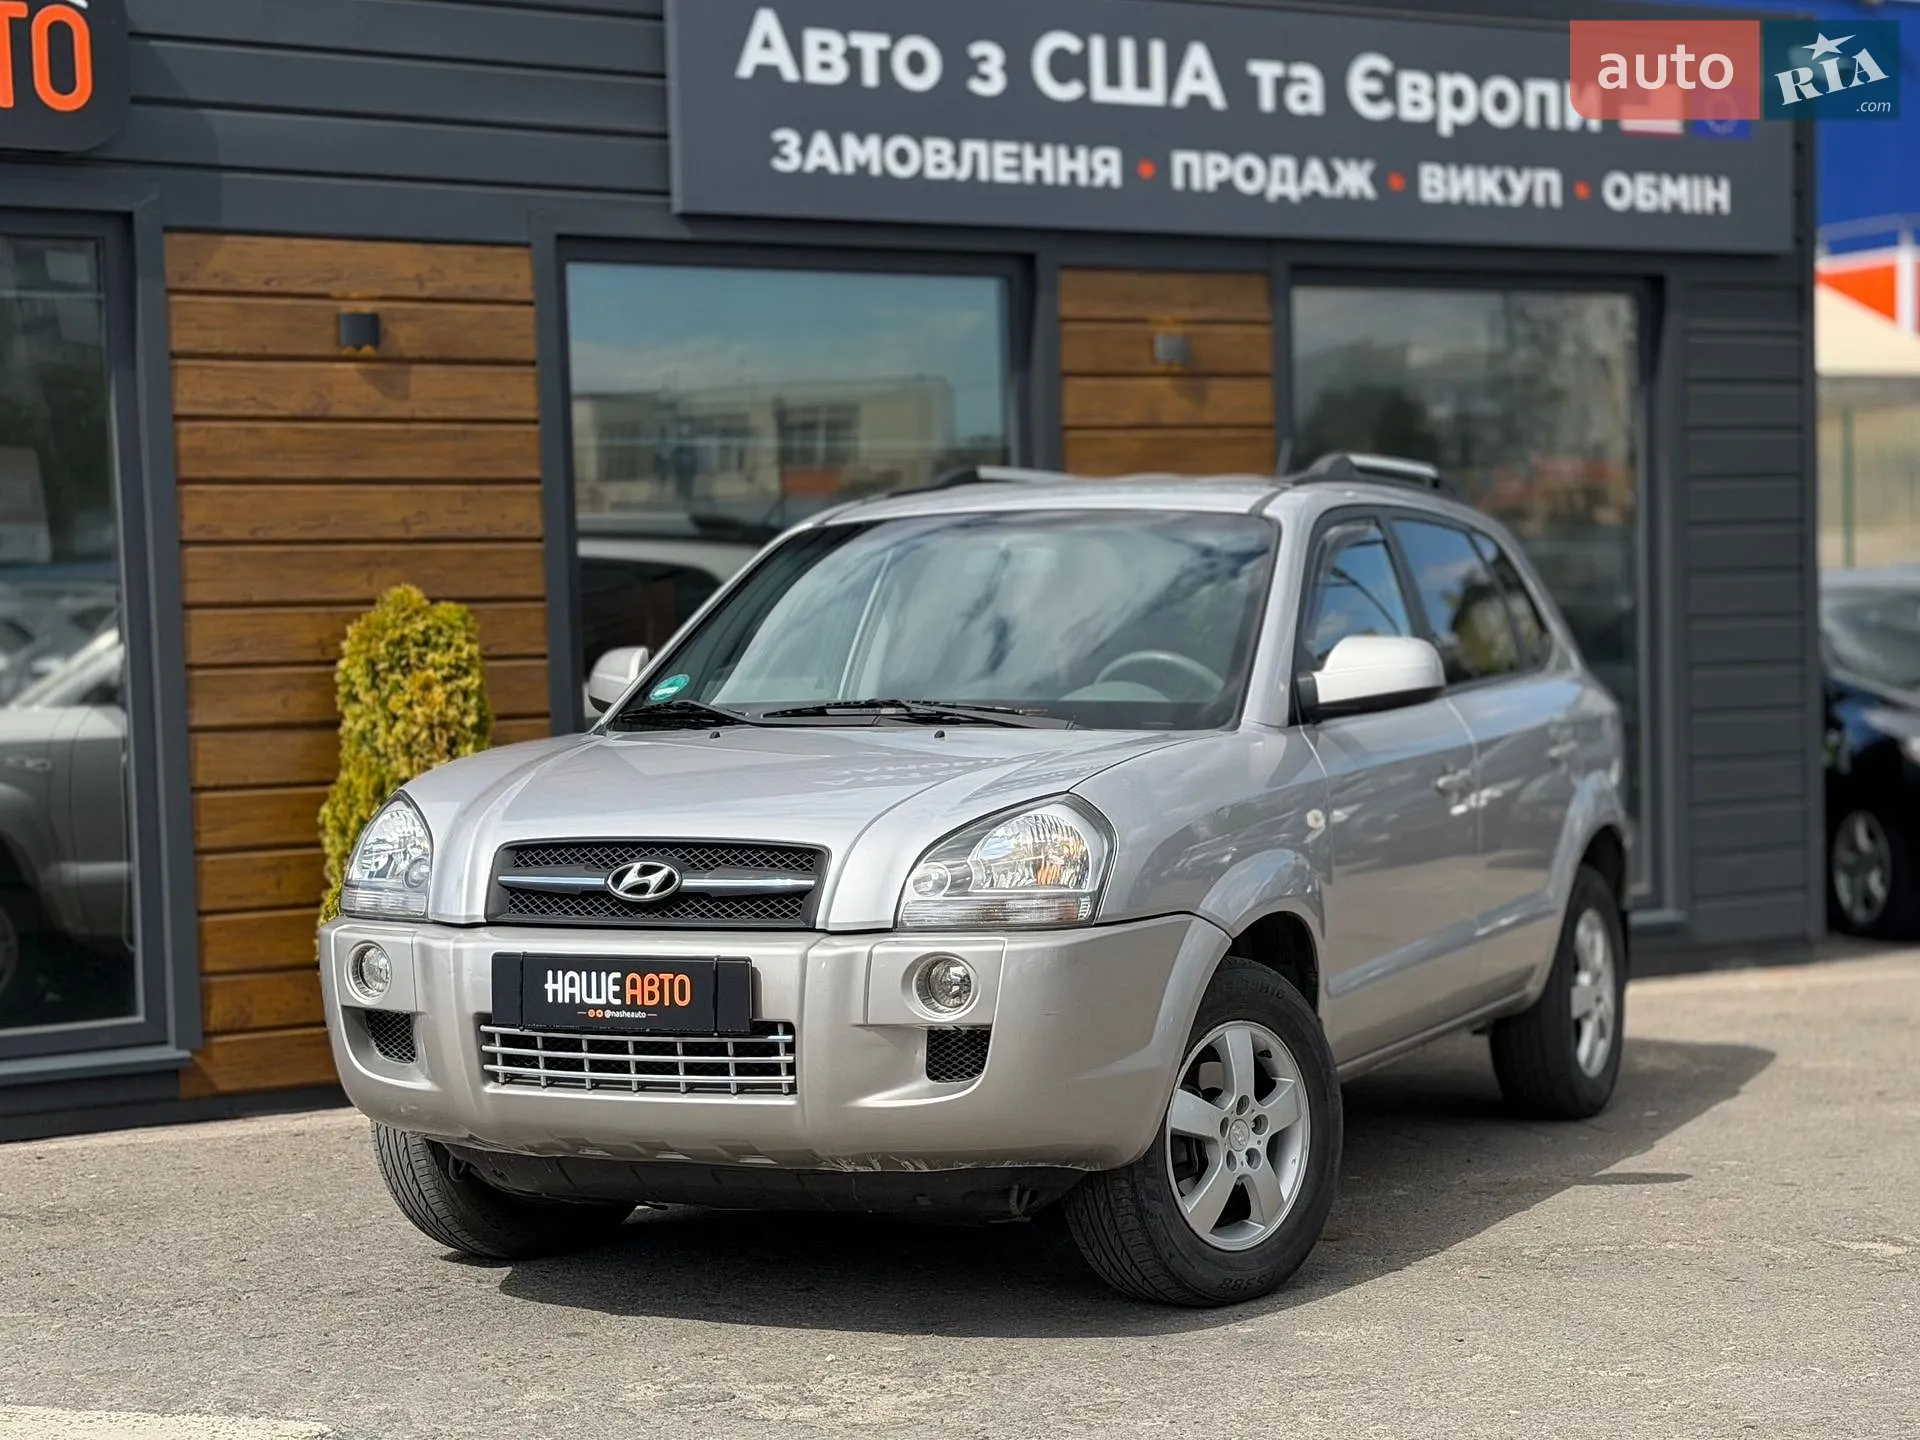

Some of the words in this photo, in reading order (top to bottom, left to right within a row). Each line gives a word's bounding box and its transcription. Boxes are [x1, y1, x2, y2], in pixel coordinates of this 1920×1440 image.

[735, 7, 943, 92] Авто
[966, 40, 1007, 97] з
[1031, 30, 1228, 111] США
[1246, 58, 1326, 117] та
[1345, 52, 1602, 138] Європи
[770, 128, 1123, 188] ЗАМОВЛЕННЯ
[1170, 149, 1378, 203] ПРОДАЖ
[1418, 161, 1563, 208] ВИКУП
[1602, 171, 1732, 214] ОБМІН
[544, 969, 622, 1005] НАШЕ
[625, 972, 691, 1007] АВТО
[604, 1009, 647, 1018] @nasheauto
